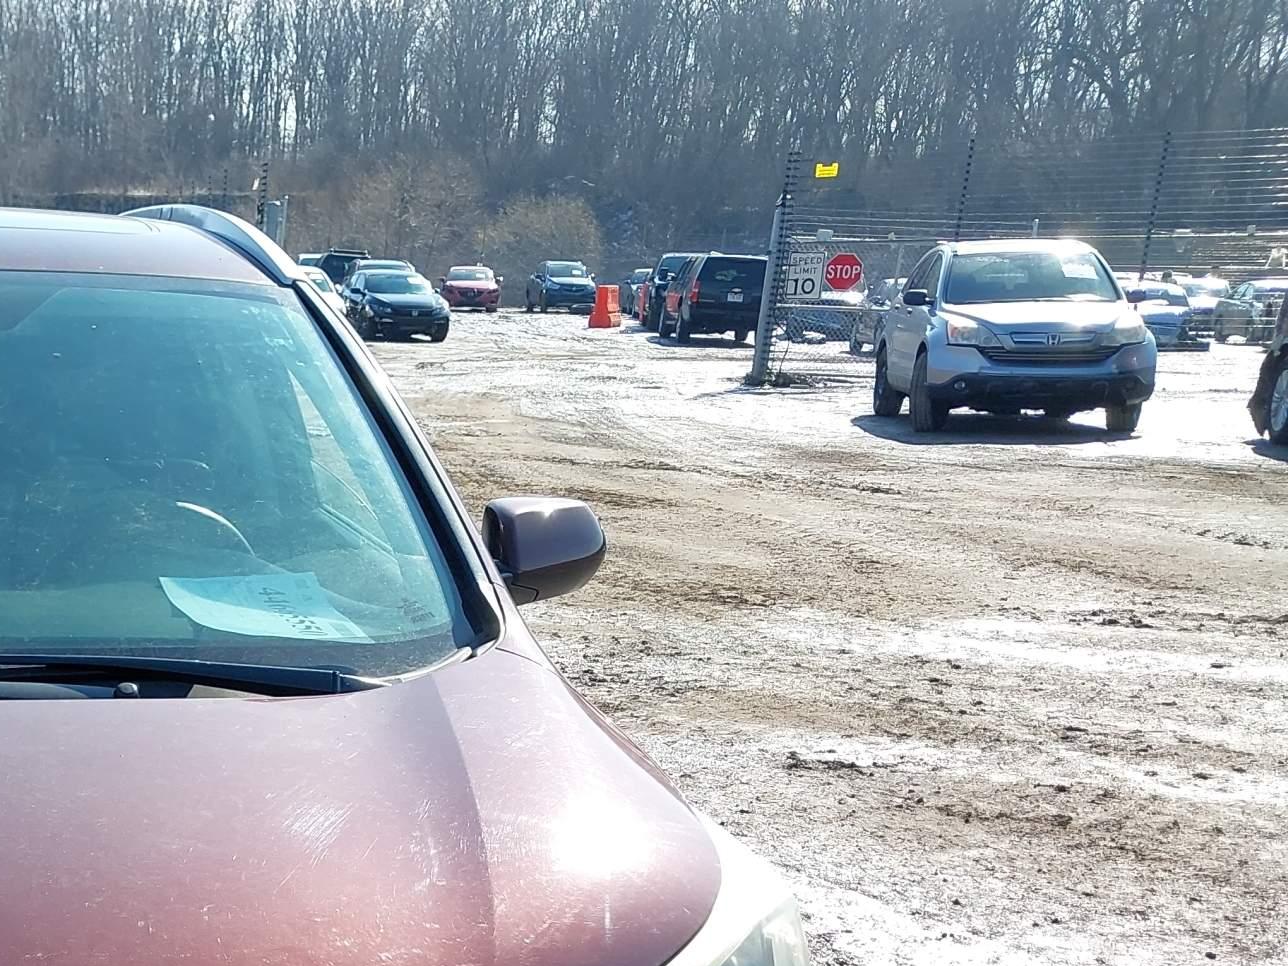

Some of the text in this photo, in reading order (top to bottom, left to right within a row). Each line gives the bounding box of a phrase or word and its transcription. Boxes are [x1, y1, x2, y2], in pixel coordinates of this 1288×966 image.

[792, 256, 822, 265] SPEED
[794, 266, 818, 275] LIMIT
[826, 265, 861, 279] STOP
[791, 278, 815, 295] 10
